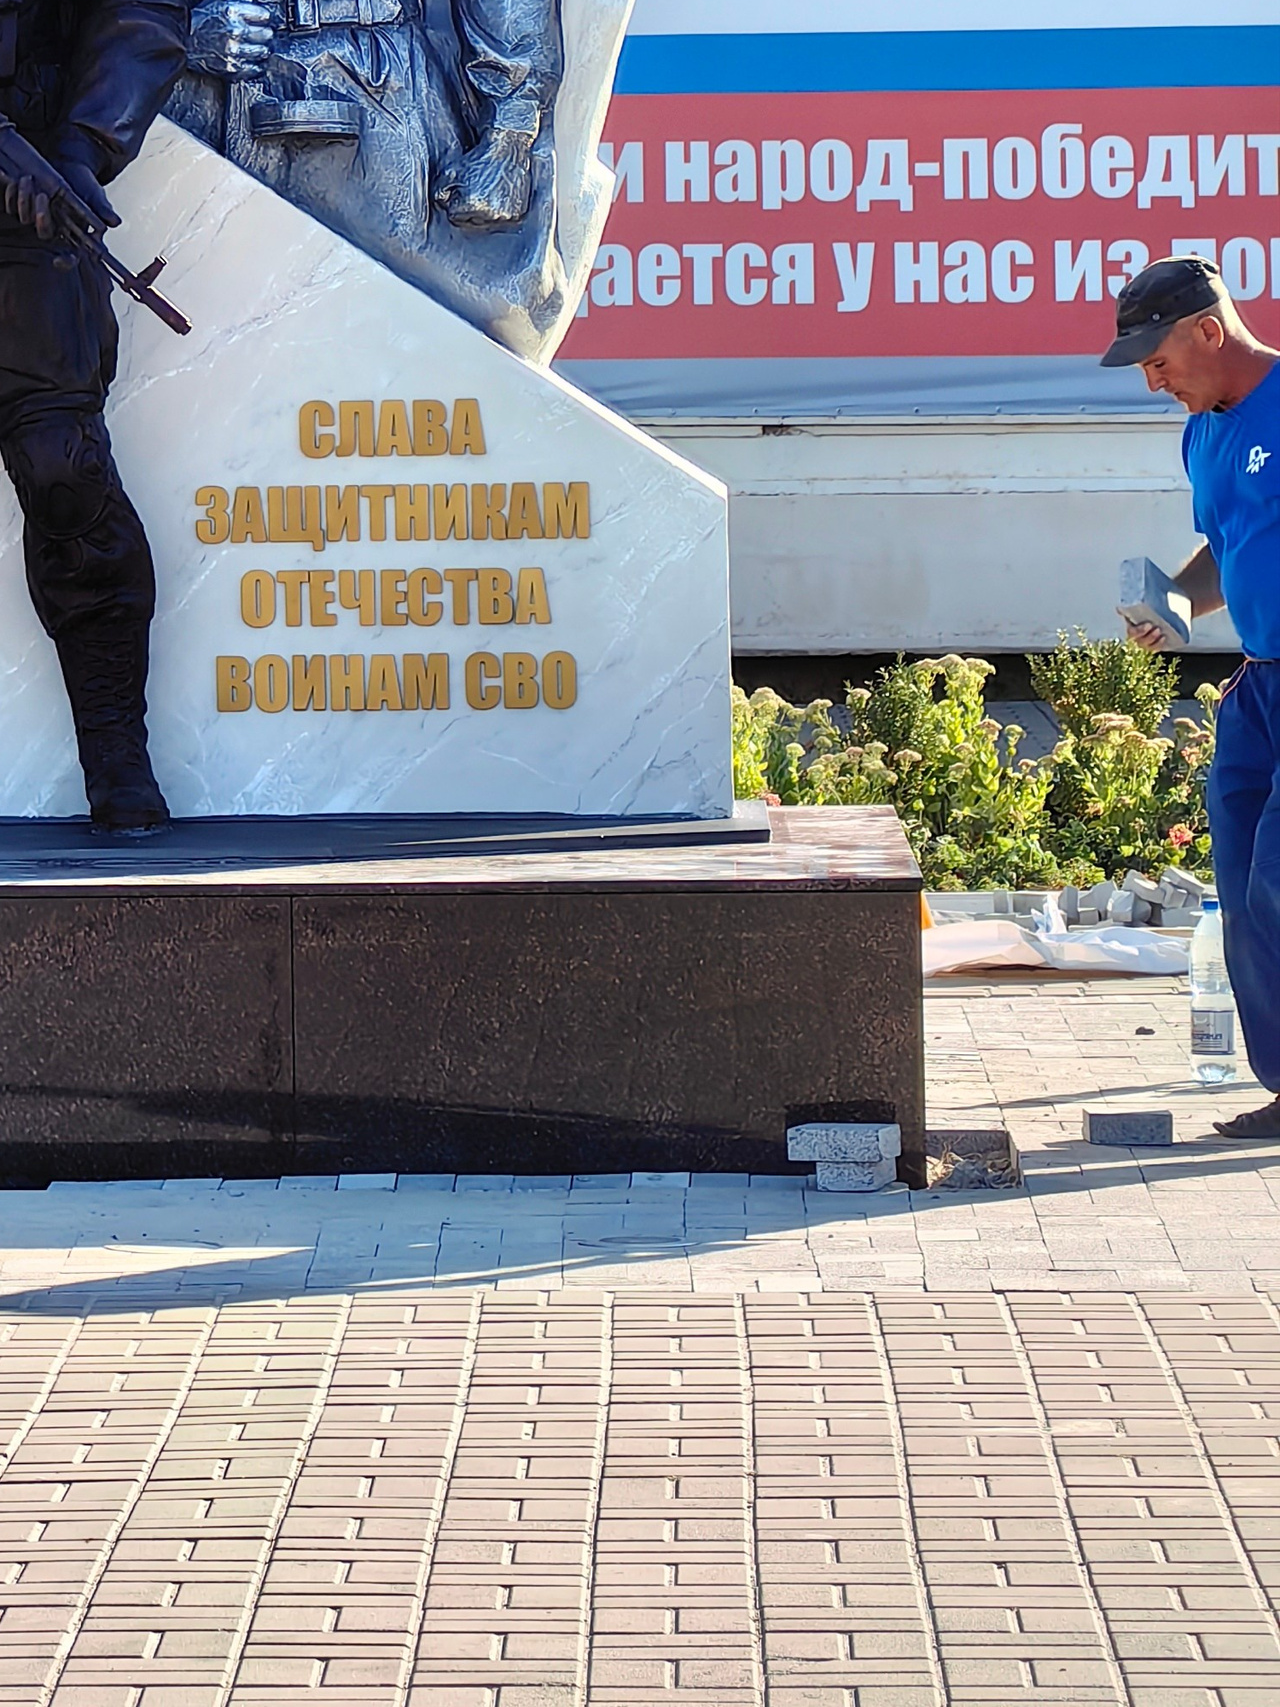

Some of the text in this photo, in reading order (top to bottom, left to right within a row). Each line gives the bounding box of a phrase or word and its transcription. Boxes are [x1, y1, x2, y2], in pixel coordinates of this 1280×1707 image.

[664, 122, 1280, 212] народ-победит
[575, 242, 816, 318] ается
[831, 241, 876, 313] у
[893, 239, 1035, 304] нас
[1054, 238, 1160, 302] из
[298, 398, 487, 459] СЛАВА
[194, 481, 591, 552] ЗАЩИТНИКАМ
[240, 567, 552, 629] ОТЕЧЕСТВА
[216, 650, 578, 713] ВОИНАМ СВО
